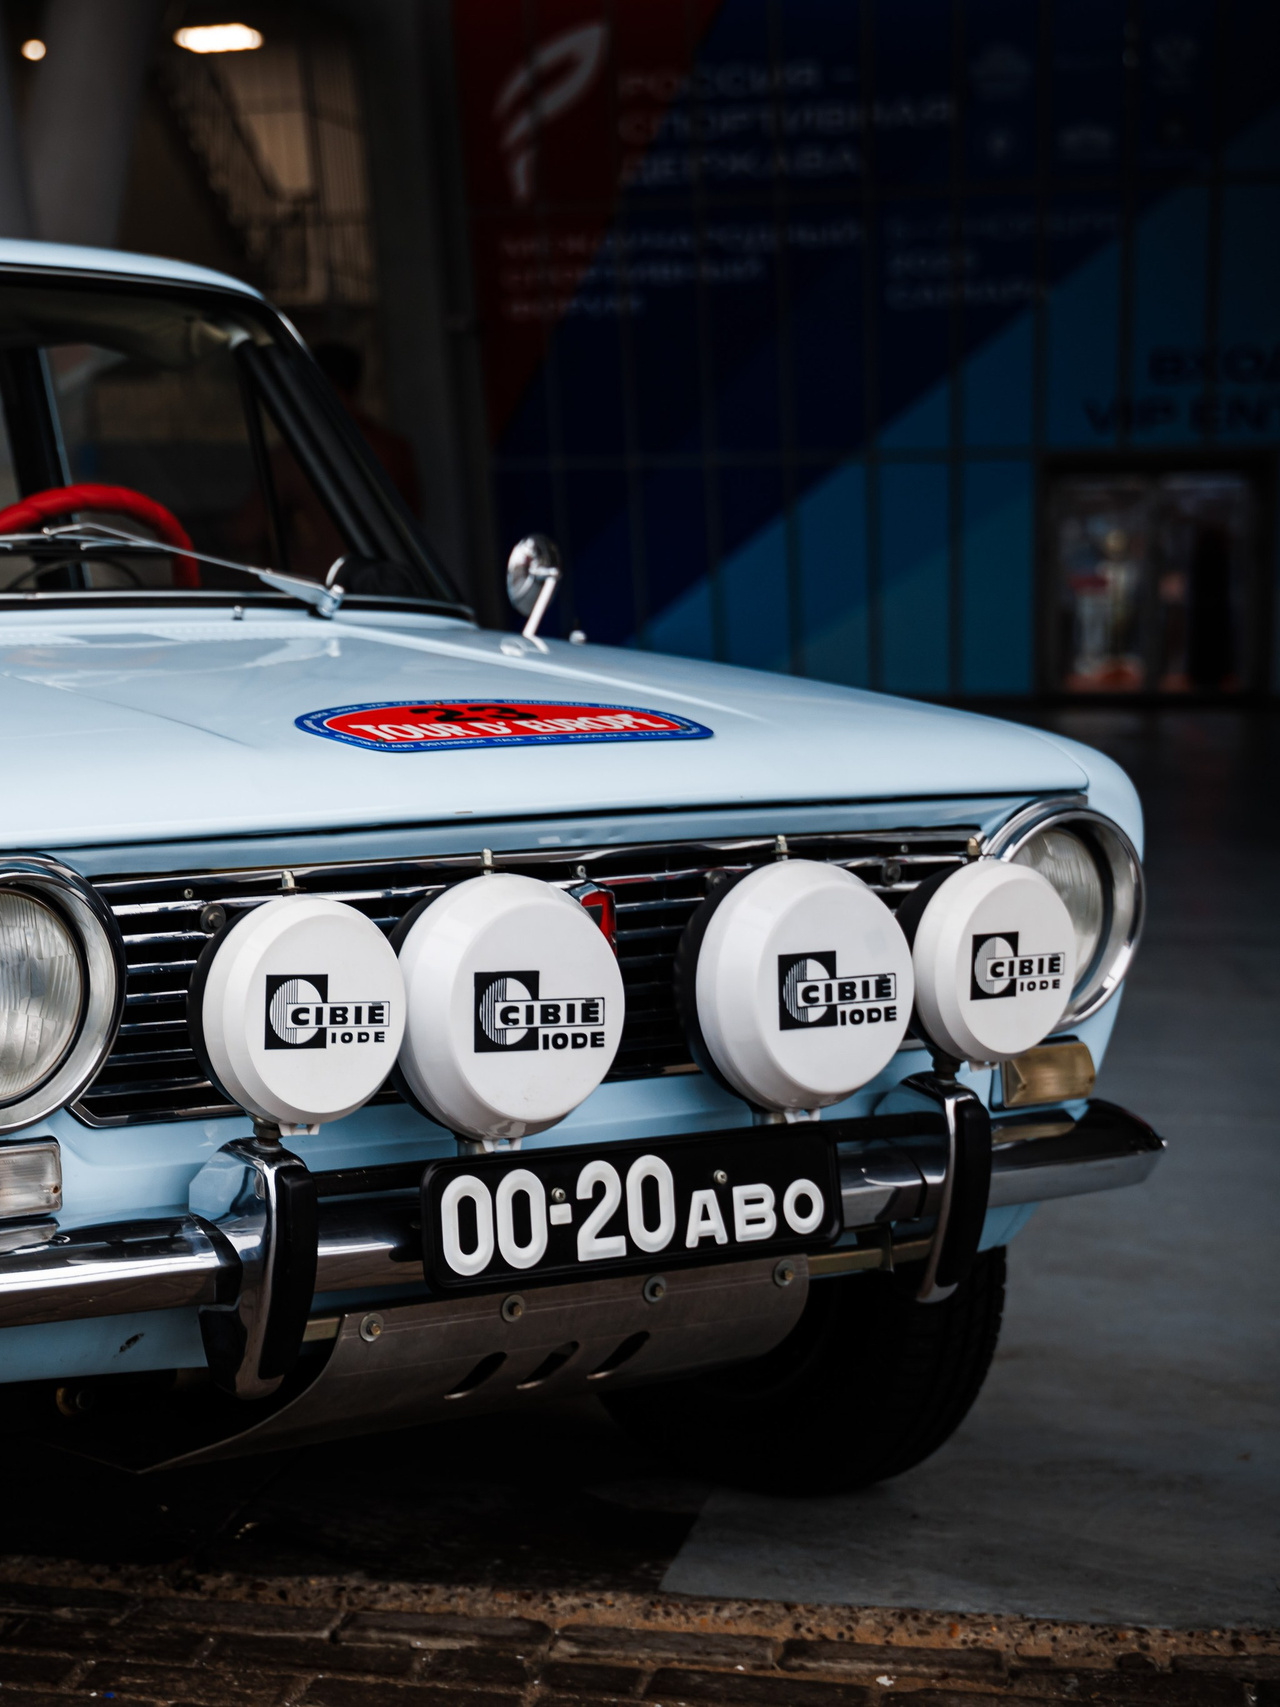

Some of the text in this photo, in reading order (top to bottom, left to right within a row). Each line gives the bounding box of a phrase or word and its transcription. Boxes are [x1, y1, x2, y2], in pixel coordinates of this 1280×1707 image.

[410, 705, 540, 723] 23
[349, 721, 482, 740] TOUR
[1020, 979, 1061, 993] IODE
[839, 1005, 898, 1026] IODE
[331, 1031, 386, 1044] IODE
[542, 1031, 606, 1051] IODE
[440, 1154, 676, 1277] 00-20
